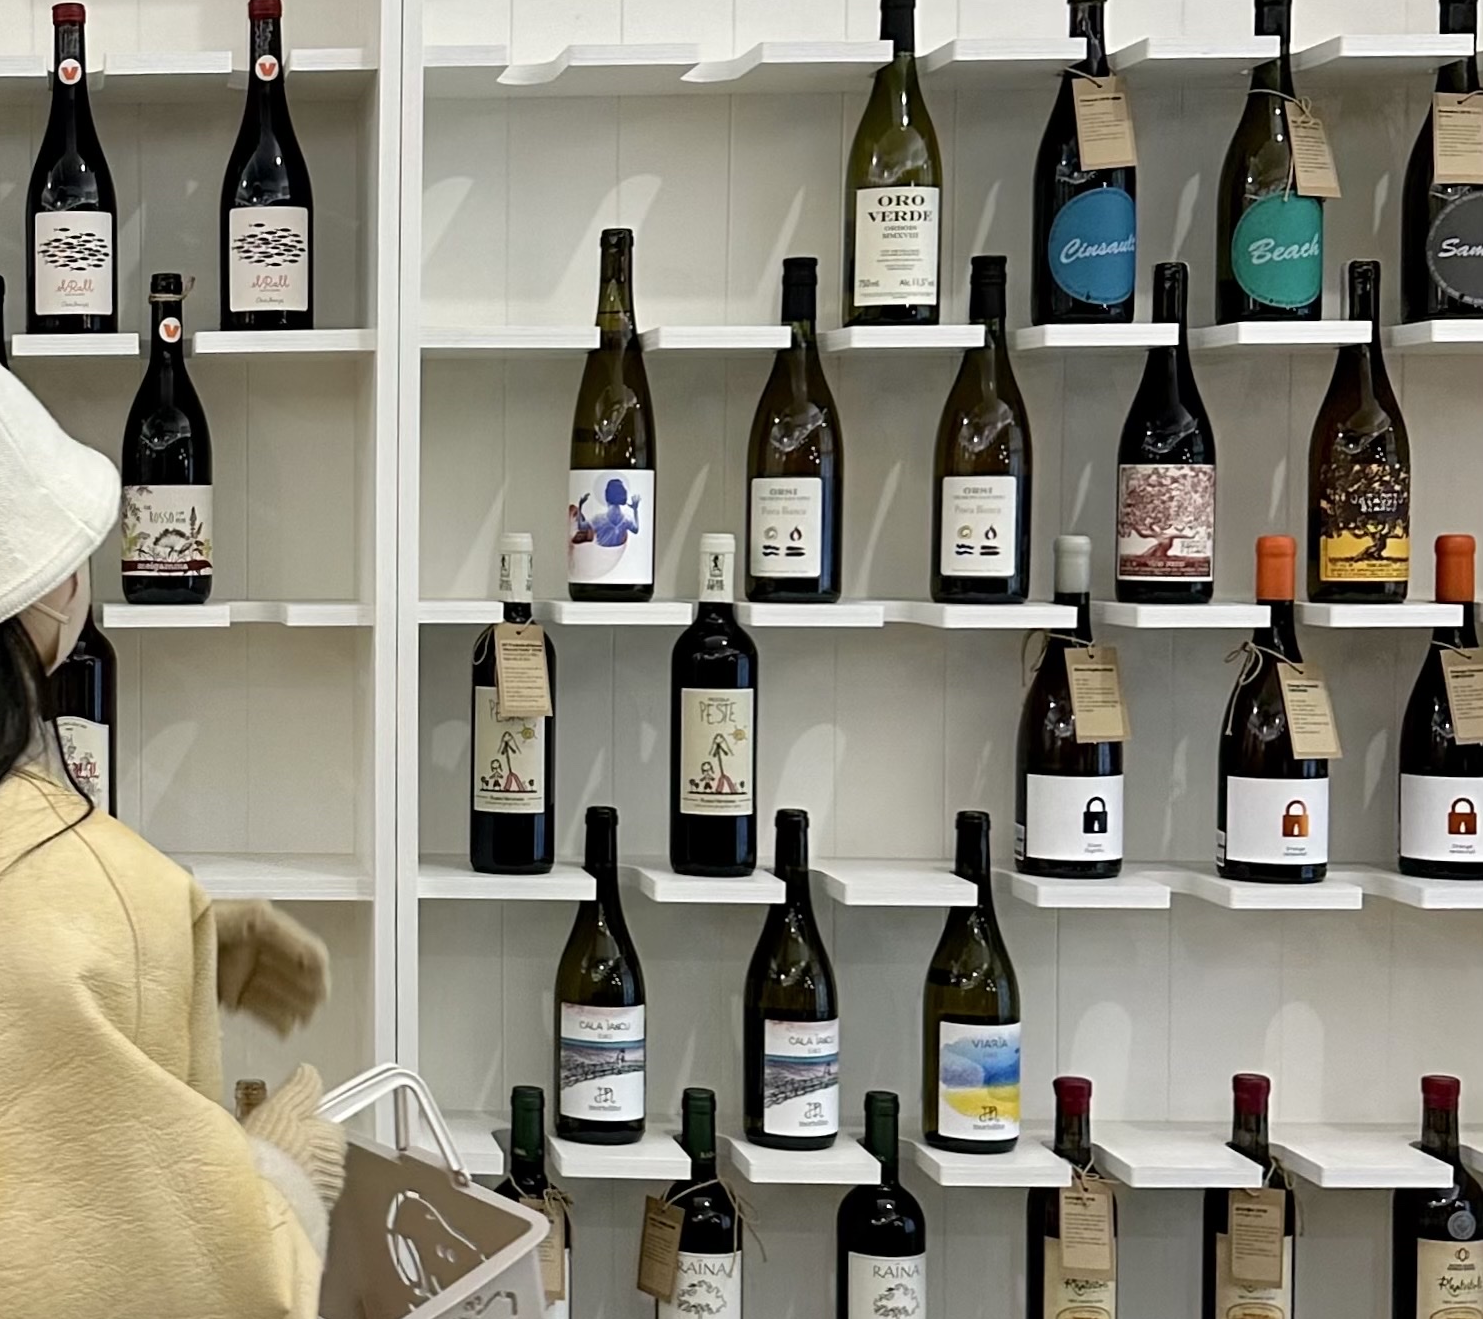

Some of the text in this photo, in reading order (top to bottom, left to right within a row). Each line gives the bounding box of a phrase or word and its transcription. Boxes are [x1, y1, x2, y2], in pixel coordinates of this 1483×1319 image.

[877, 195, 925, 207] ORO
[867, 210, 933, 222] VERDE
[1248, 232, 1320, 265] Beach
[699, 701, 738, 724] PESTE
